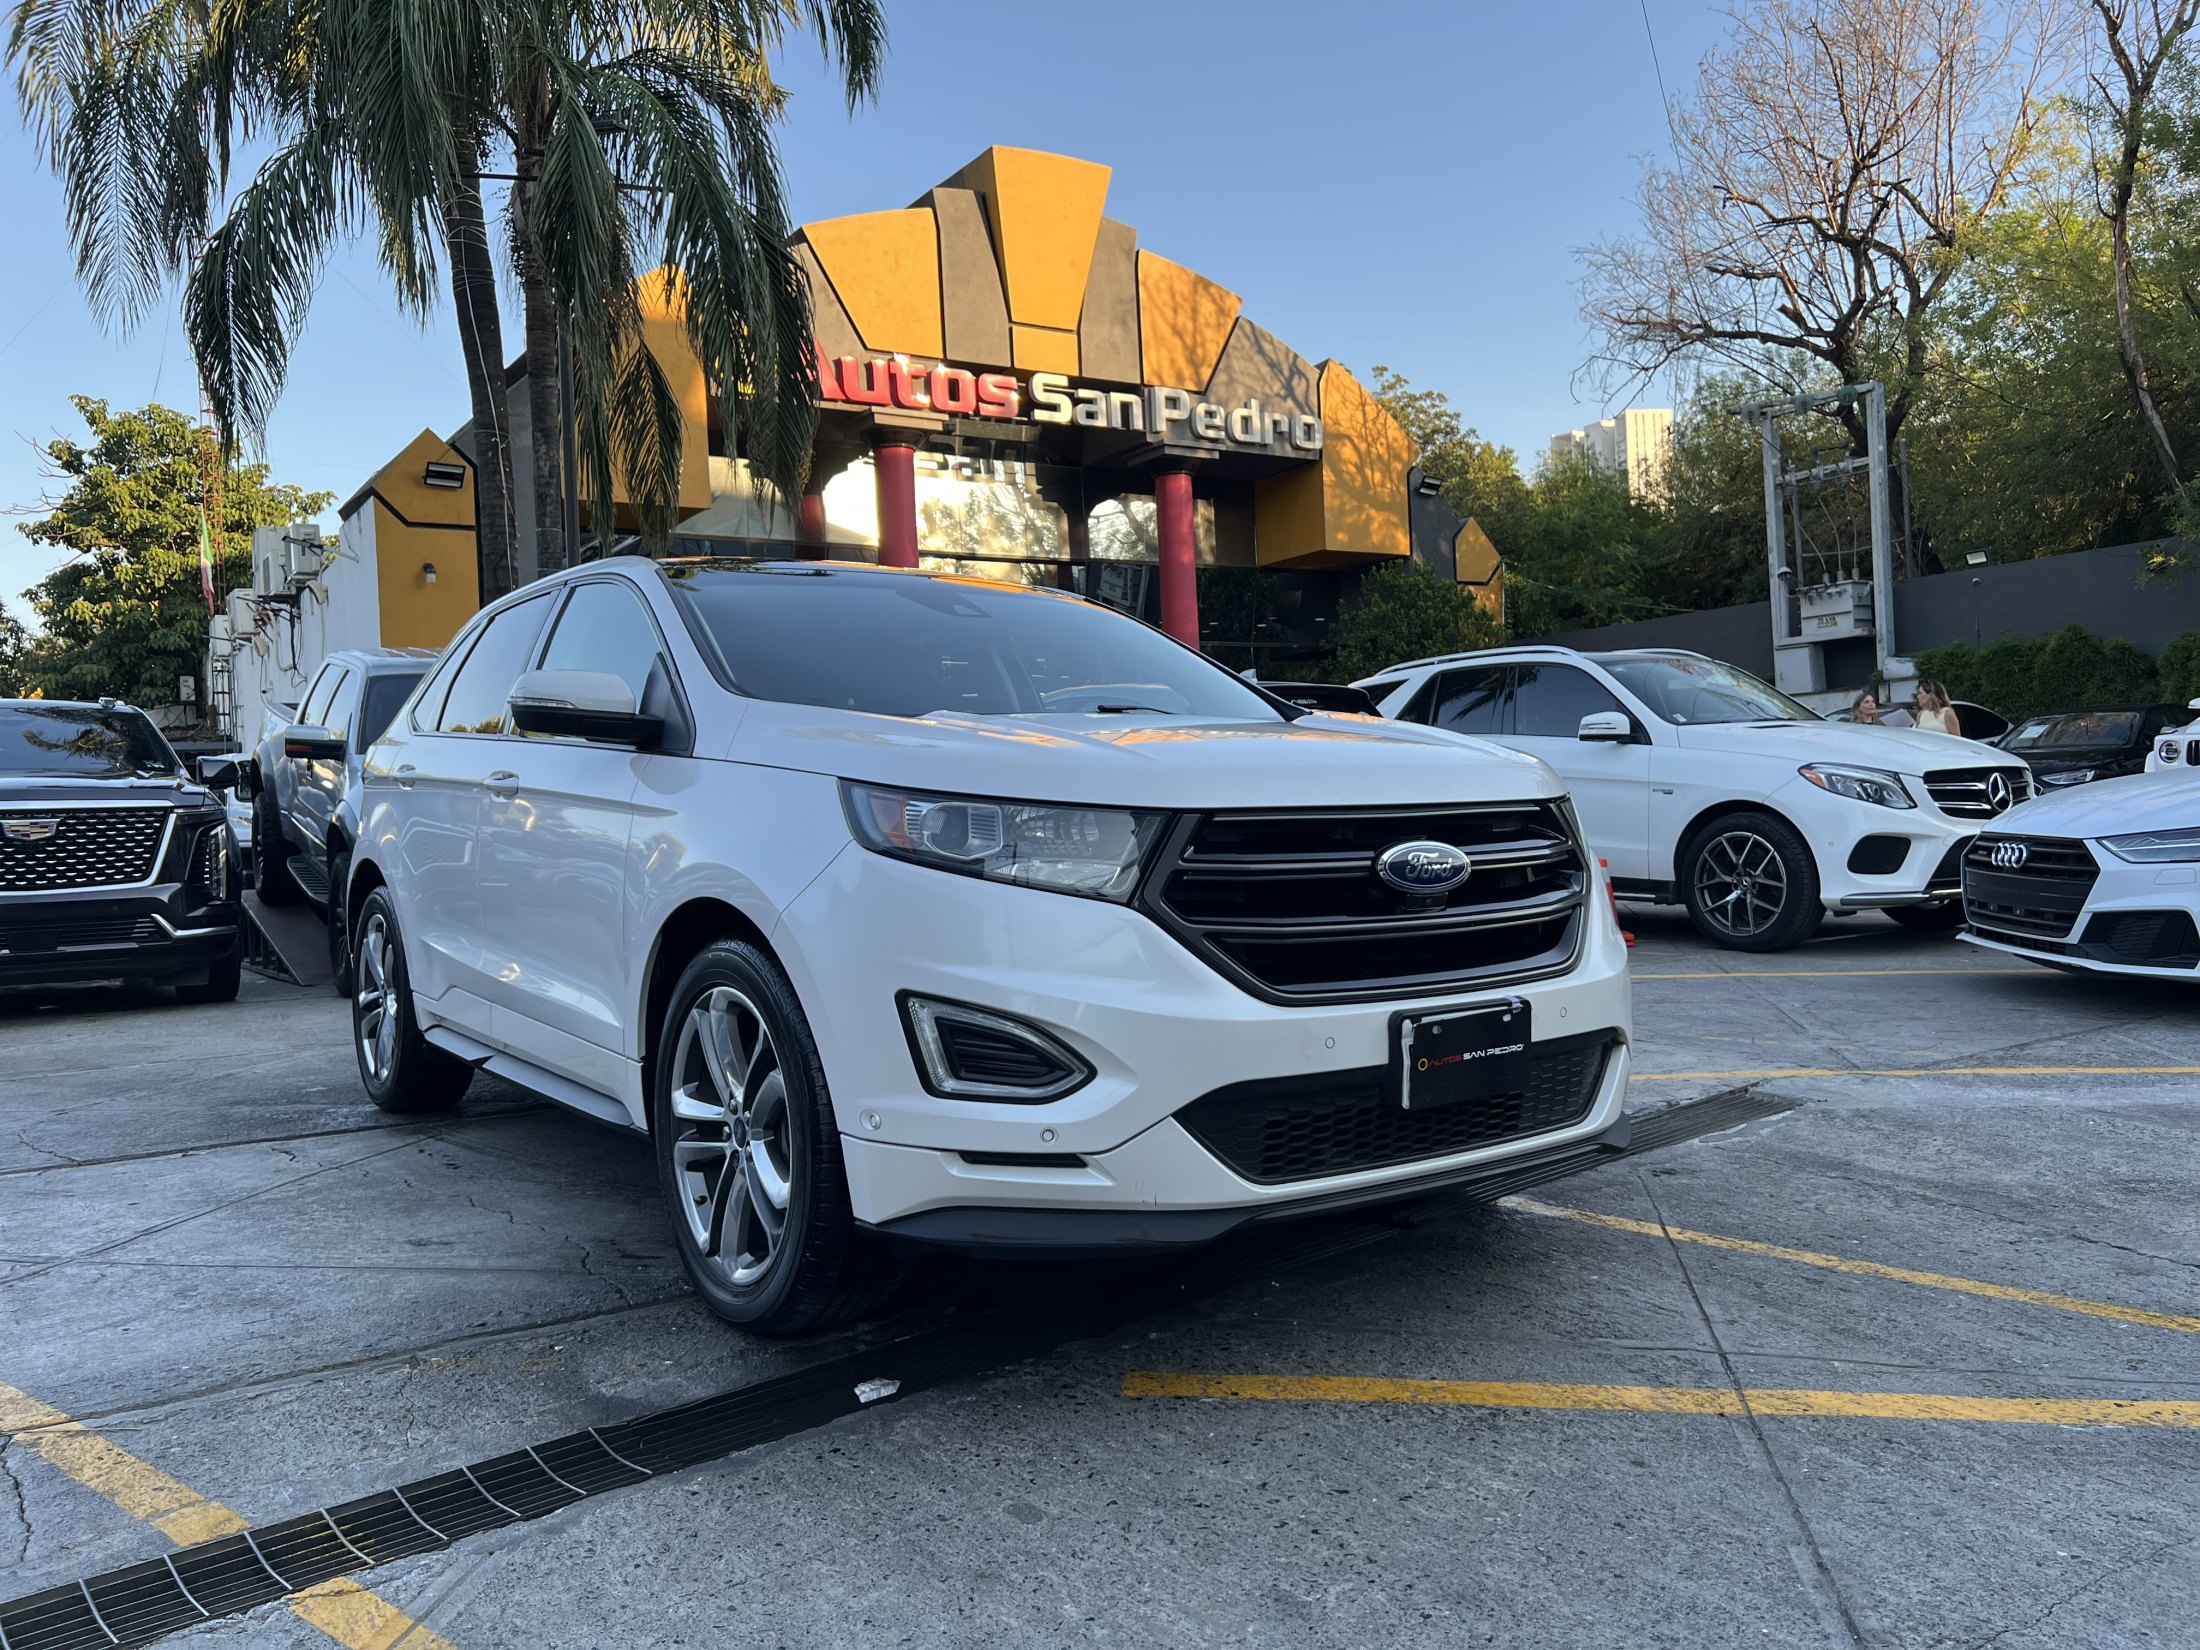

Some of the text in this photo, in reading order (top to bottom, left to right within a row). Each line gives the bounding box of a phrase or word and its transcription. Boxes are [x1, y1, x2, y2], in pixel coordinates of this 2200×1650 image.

[1405, 851, 1454, 880] Ford
[1429, 1043, 1523, 1067] AUTOS SAN PEDRO
